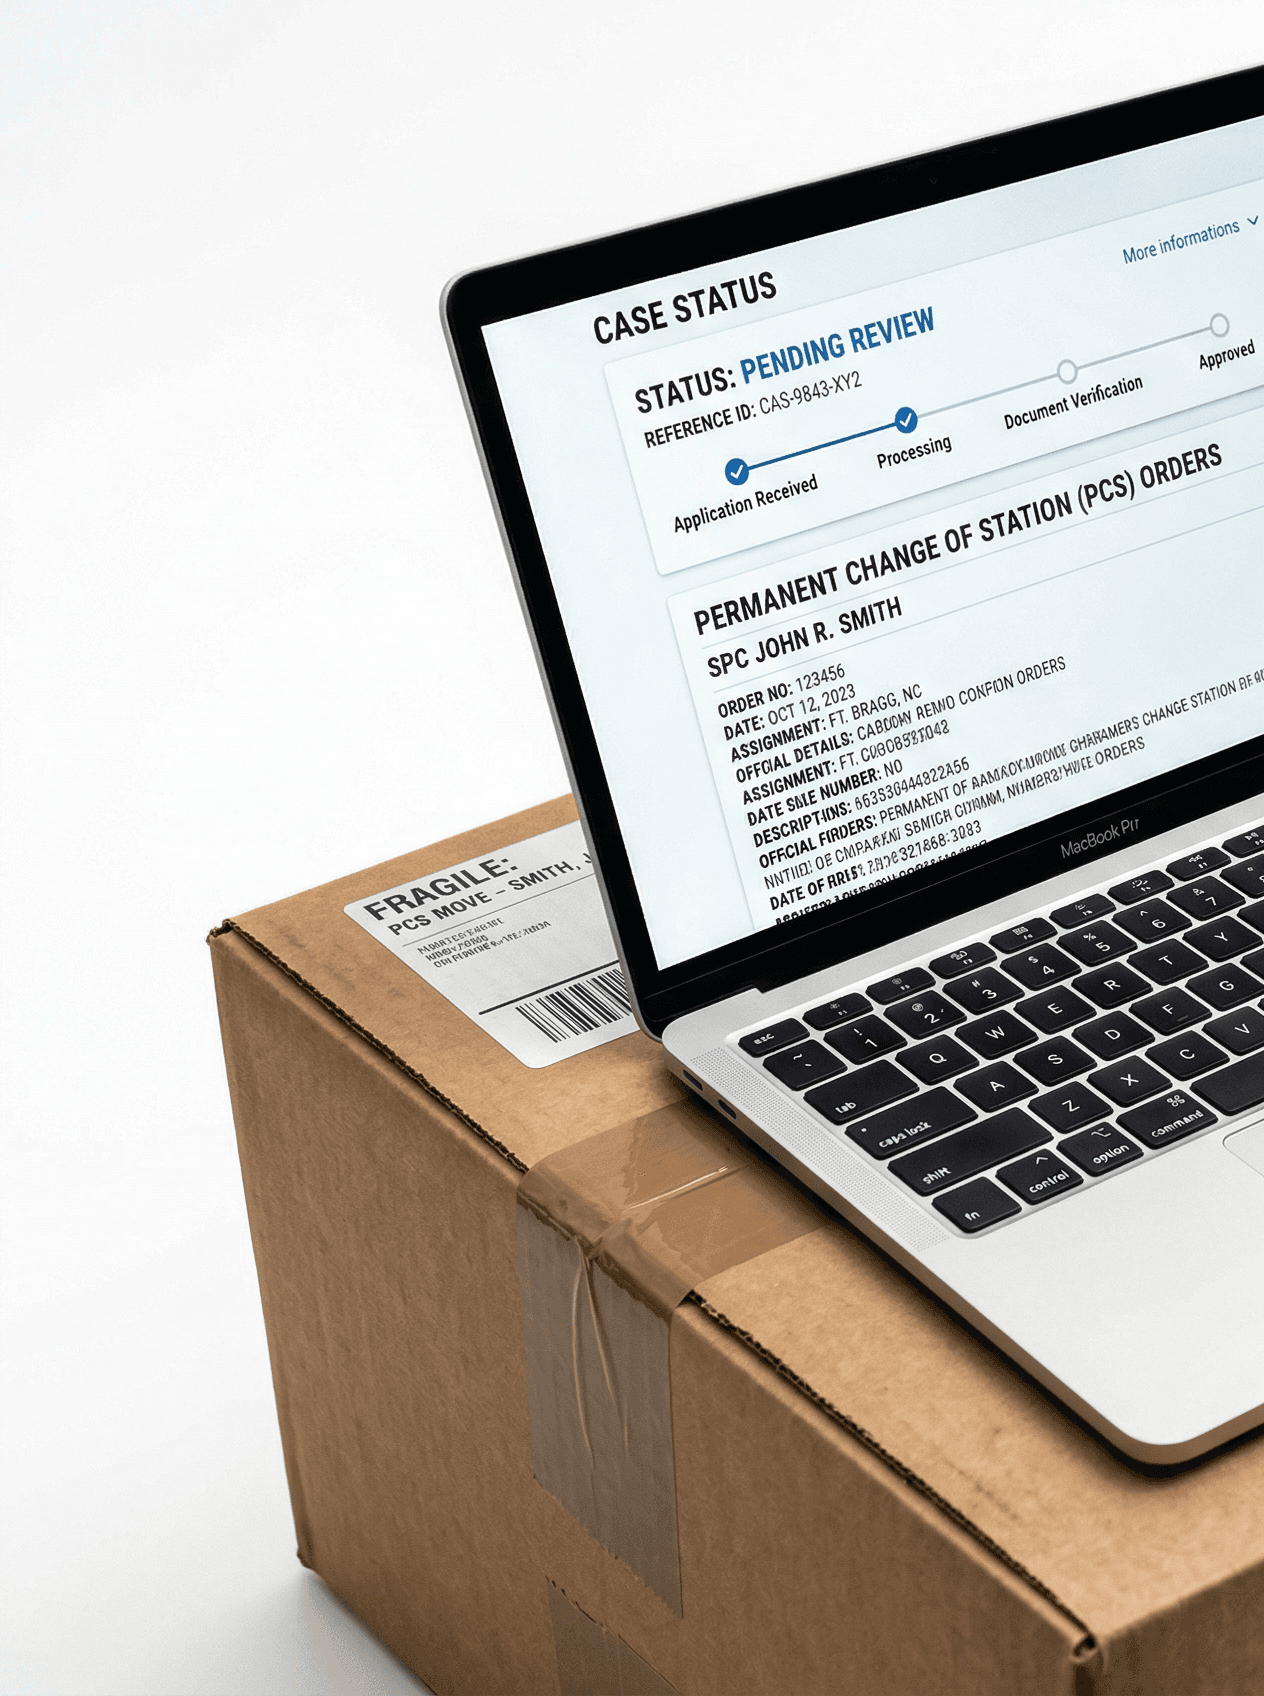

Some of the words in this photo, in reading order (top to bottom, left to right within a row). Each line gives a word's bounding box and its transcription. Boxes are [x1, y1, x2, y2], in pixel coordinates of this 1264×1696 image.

[1122, 244, 1158, 264] More
[1158, 221, 1240, 254] informations
[593, 300, 669, 345] CASE
[672, 271, 777, 323] STATUS
[634, 366, 737, 414] STATUS:
[739, 333, 846, 385] PENDING
[848, 306, 934, 353] REVIEW
[1199, 338, 1256, 371] Approved
[643, 408, 734, 449] REFERENCE
[735, 403, 757, 422] ID:
[759, 370, 863, 415] CAS-9843-XY2
[1003, 397, 1070, 430] Document
[1069, 377, 1143, 409] Verification
[876, 436, 953, 469] Processing
[674, 498, 753, 534] Application
[754, 473, 819, 507] Received
[693, 566, 838, 636] PERMANENT
[845, 534, 941, 586] CHANGE
[944, 523, 973, 553] OF
[978, 491, 1073, 542] STATION
[1077, 469, 1135, 516] (PCS)
[1139, 443, 1222, 489] ORDERS
[707, 647, 750, 678] SPC
[755, 626, 810, 663] JOHN
[812, 621, 834, 644] R.
[838, 595, 902, 634] SMITH
[717, 690, 765, 719] ORDER
[766, 682, 794, 702] NO:
[795, 663, 845, 692] 123456
[723, 715, 765, 741] DATE:
[767, 702, 795, 726] OCT
[799, 696, 821, 715] 12,
[821, 683, 856, 707] 2023
[793, 731, 854, 764] DETAILS:
[1016, 655, 1066, 685] ORDERS
[731, 717, 827, 763] ASSIGNMENT:
[828, 709, 849, 728] FT.
[850, 692, 901, 721] BRAGG,
[902, 683, 923, 703] NC
[879, 786, 949, 824] PERMANENT
[952, 778, 968, 797] OF
[1142, 697, 1190, 726] CHANGE
[1190, 680, 1237, 709] STATION
[1094, 736, 1146, 766] ORDERS
[743, 759, 837, 806] ASSIGNMENT:
[839, 751, 859, 770] FT.
[747, 801, 785, 827] DATE
[819, 767, 882, 801] NUMBER:
[883, 758, 903, 778] NO
[1061, 824, 1120, 858] MacBook
[363, 858, 518, 920] FRAGILE:
[387, 914, 432, 936] PCS
[432, 892, 492, 920] MOVE
[508, 861, 581, 891] SMITH,
[769, 885, 806, 911] DATE
[807, 877, 825, 896] OF
[1205, 897, 1216, 905] 7
[1152, 920, 1165, 928] 6
[1096, 942, 1110, 951] 5
[1215, 932, 1227, 941] Y
[1043, 966, 1054, 974] 4
[1159, 956, 1172, 964] T
[982, 990, 997, 998] 3
[1104, 980, 1120, 990] R
[1220, 981, 1234, 990] G
[925, 1014, 939, 1023] 2
[1048, 1003, 1062, 1014] E
[1162, 1004, 1173, 1014] F
[985, 1026, 1004, 1038] W
[1105, 1030, 1120, 1039] D
[1235, 1024, 1249, 1033] V
[865, 1039, 877, 1047] 1
[929, 1054, 947, 1063] Q
[1048, 1055, 1063, 1064] S
[1180, 1050, 1194, 1059] C
[990, 1082, 1005, 1091] A
[1121, 1074, 1139, 1086] X
[1062, 1100, 1080, 1112] Z
